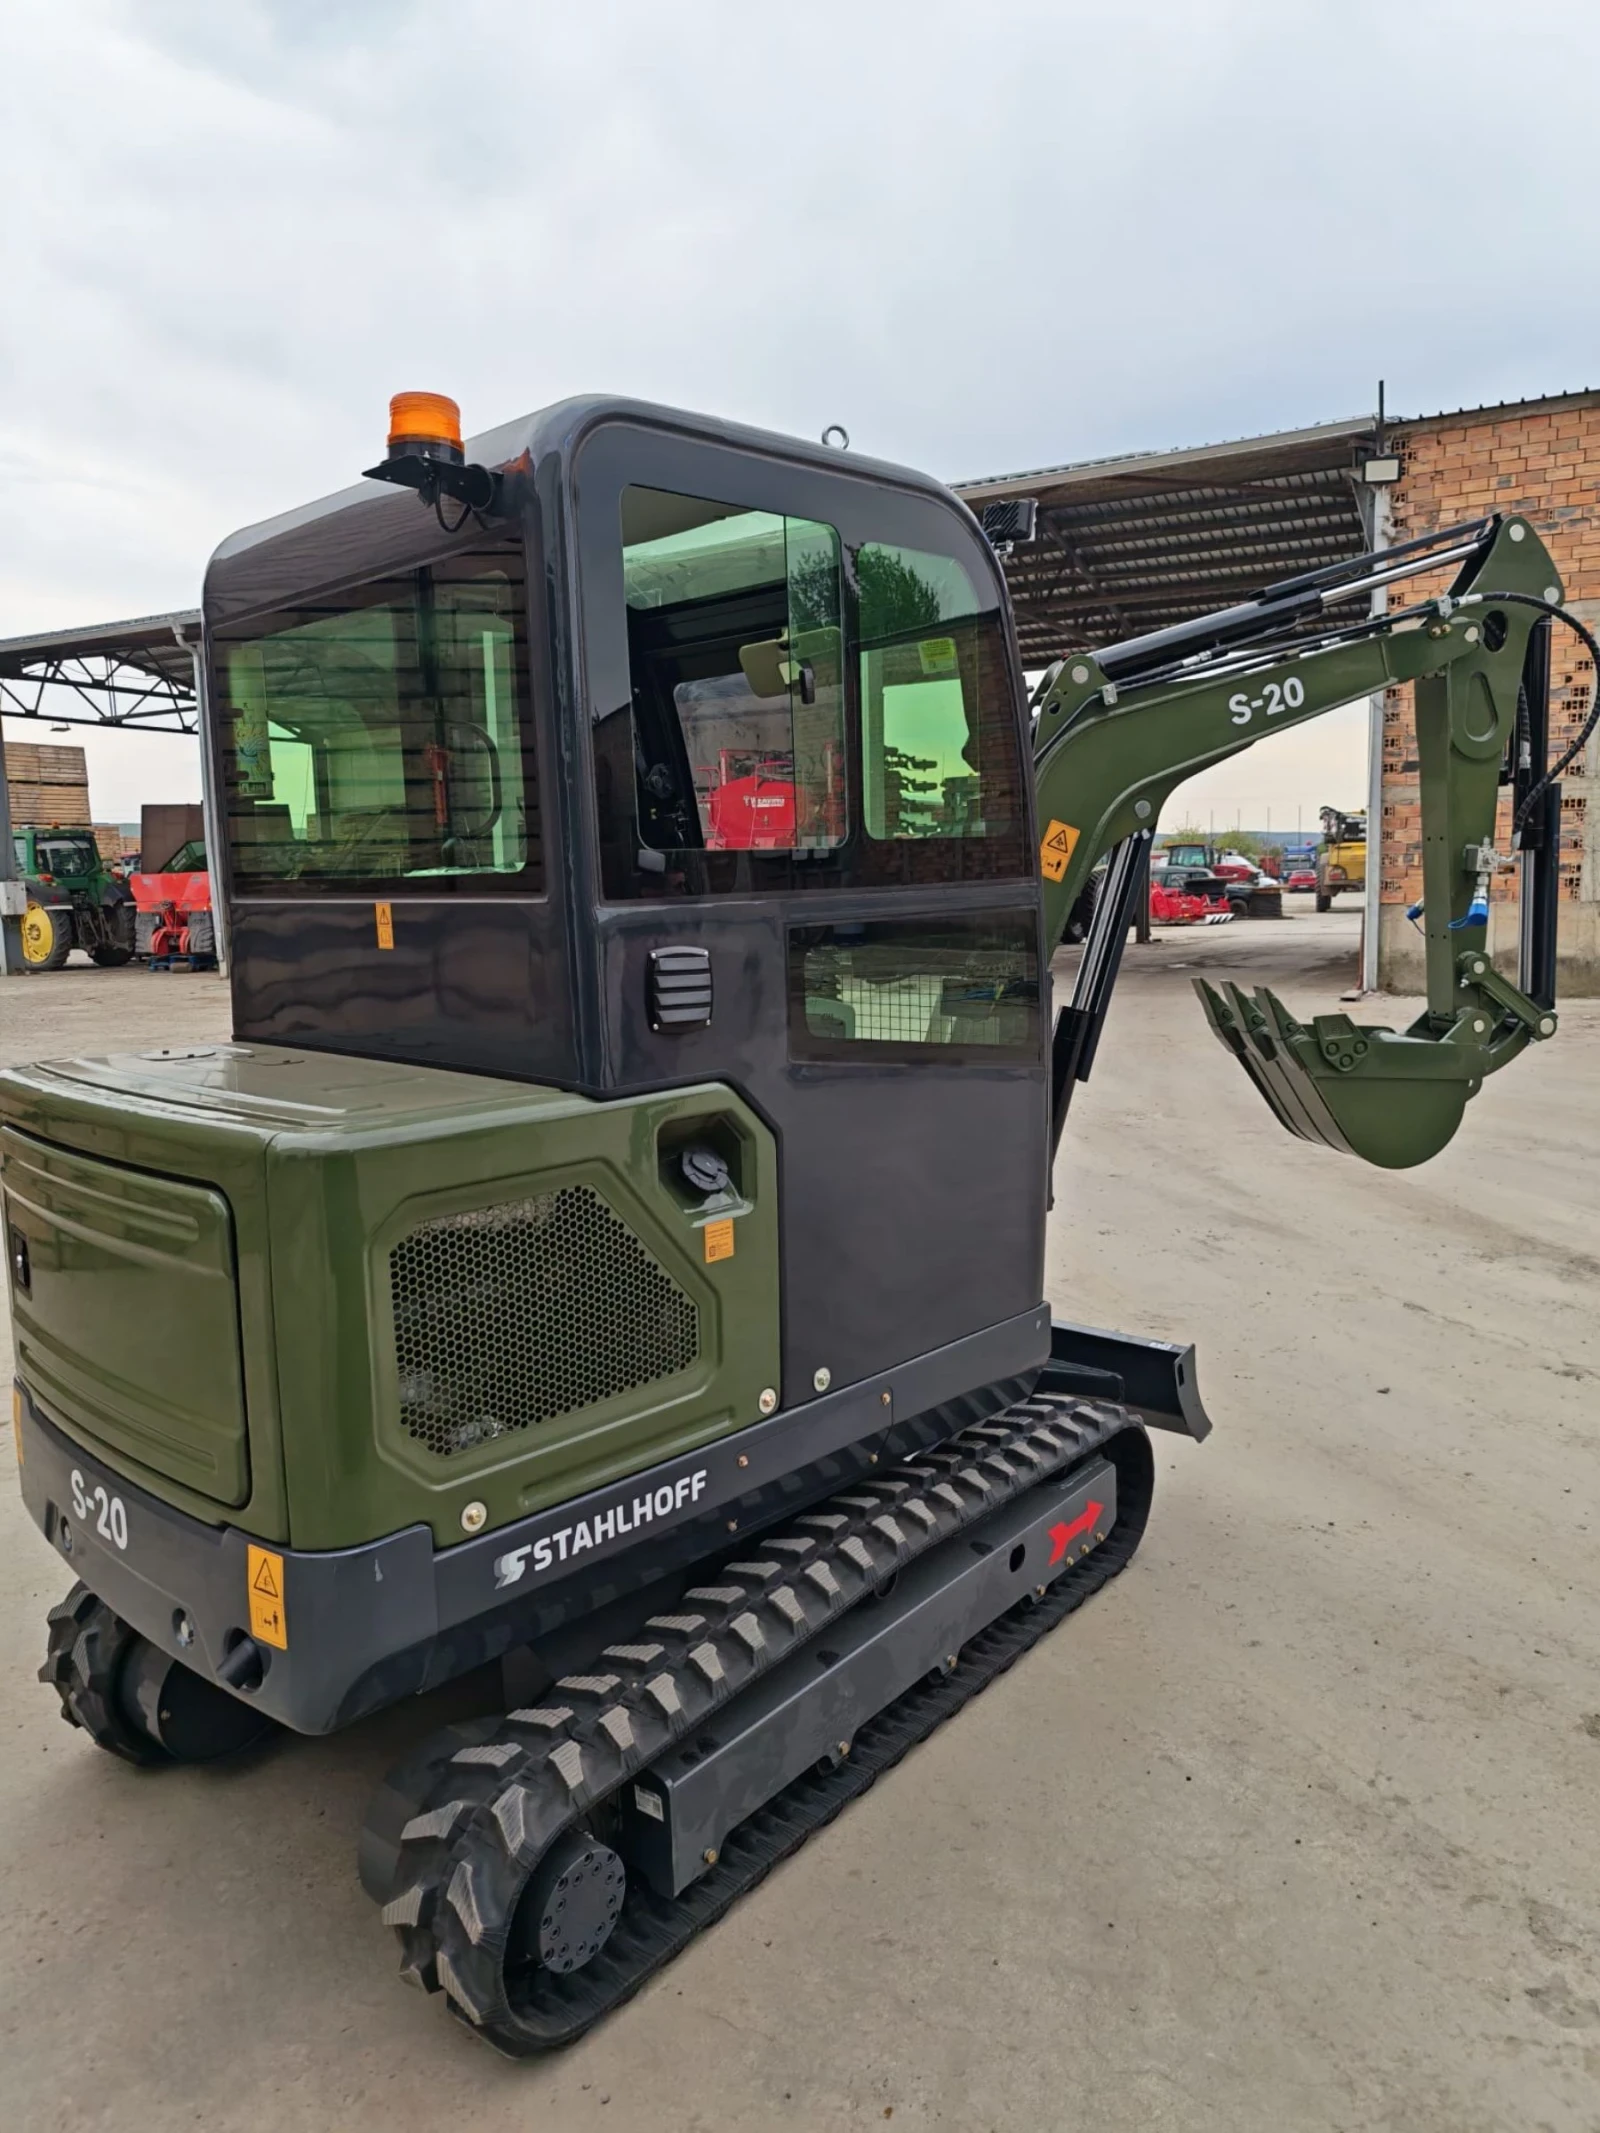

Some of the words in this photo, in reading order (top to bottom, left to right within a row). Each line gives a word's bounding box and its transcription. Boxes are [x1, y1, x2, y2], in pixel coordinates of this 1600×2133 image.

[1228, 676, 1305, 725] S-20
[71, 1469, 128, 1550] S-20
[532, 1469, 708, 1572] STAHLHOFF
